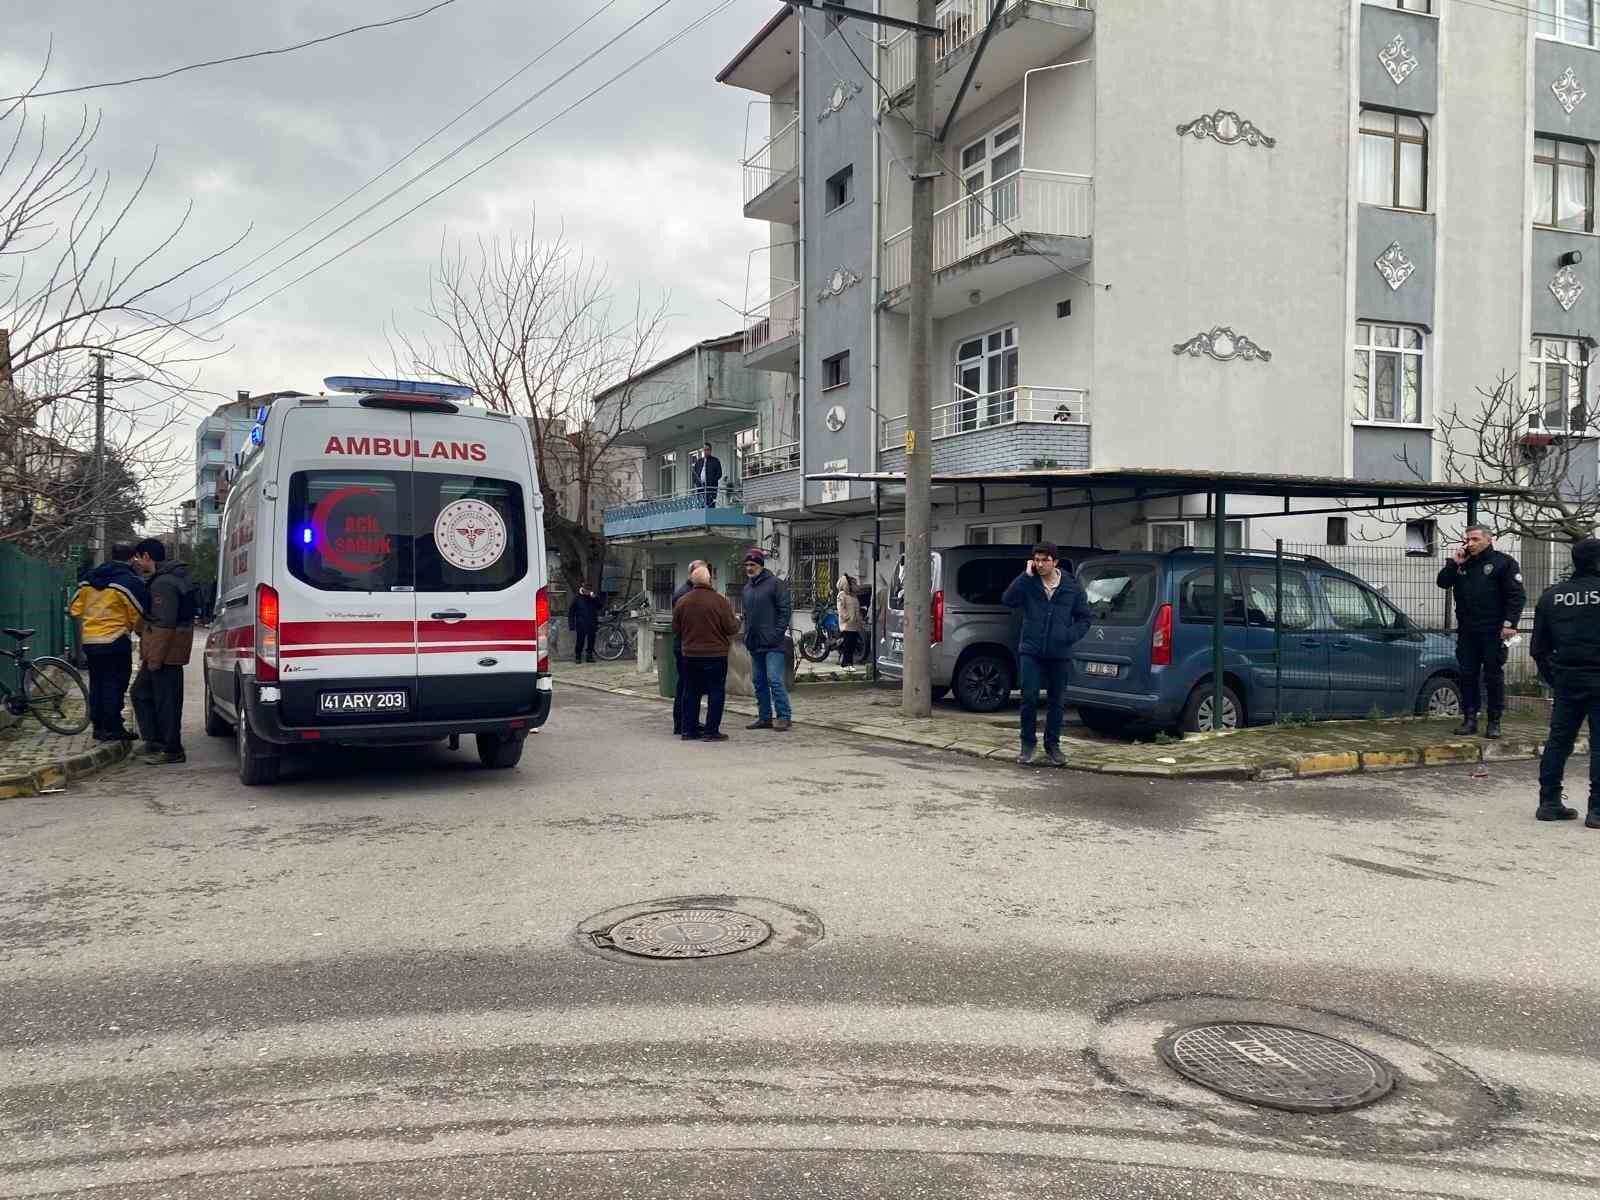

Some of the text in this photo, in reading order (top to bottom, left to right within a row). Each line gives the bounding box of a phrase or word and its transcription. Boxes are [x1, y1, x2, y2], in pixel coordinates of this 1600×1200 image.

[324, 436, 487, 461] AMBULANS
[324, 693, 402, 709] 41 ARY 203
